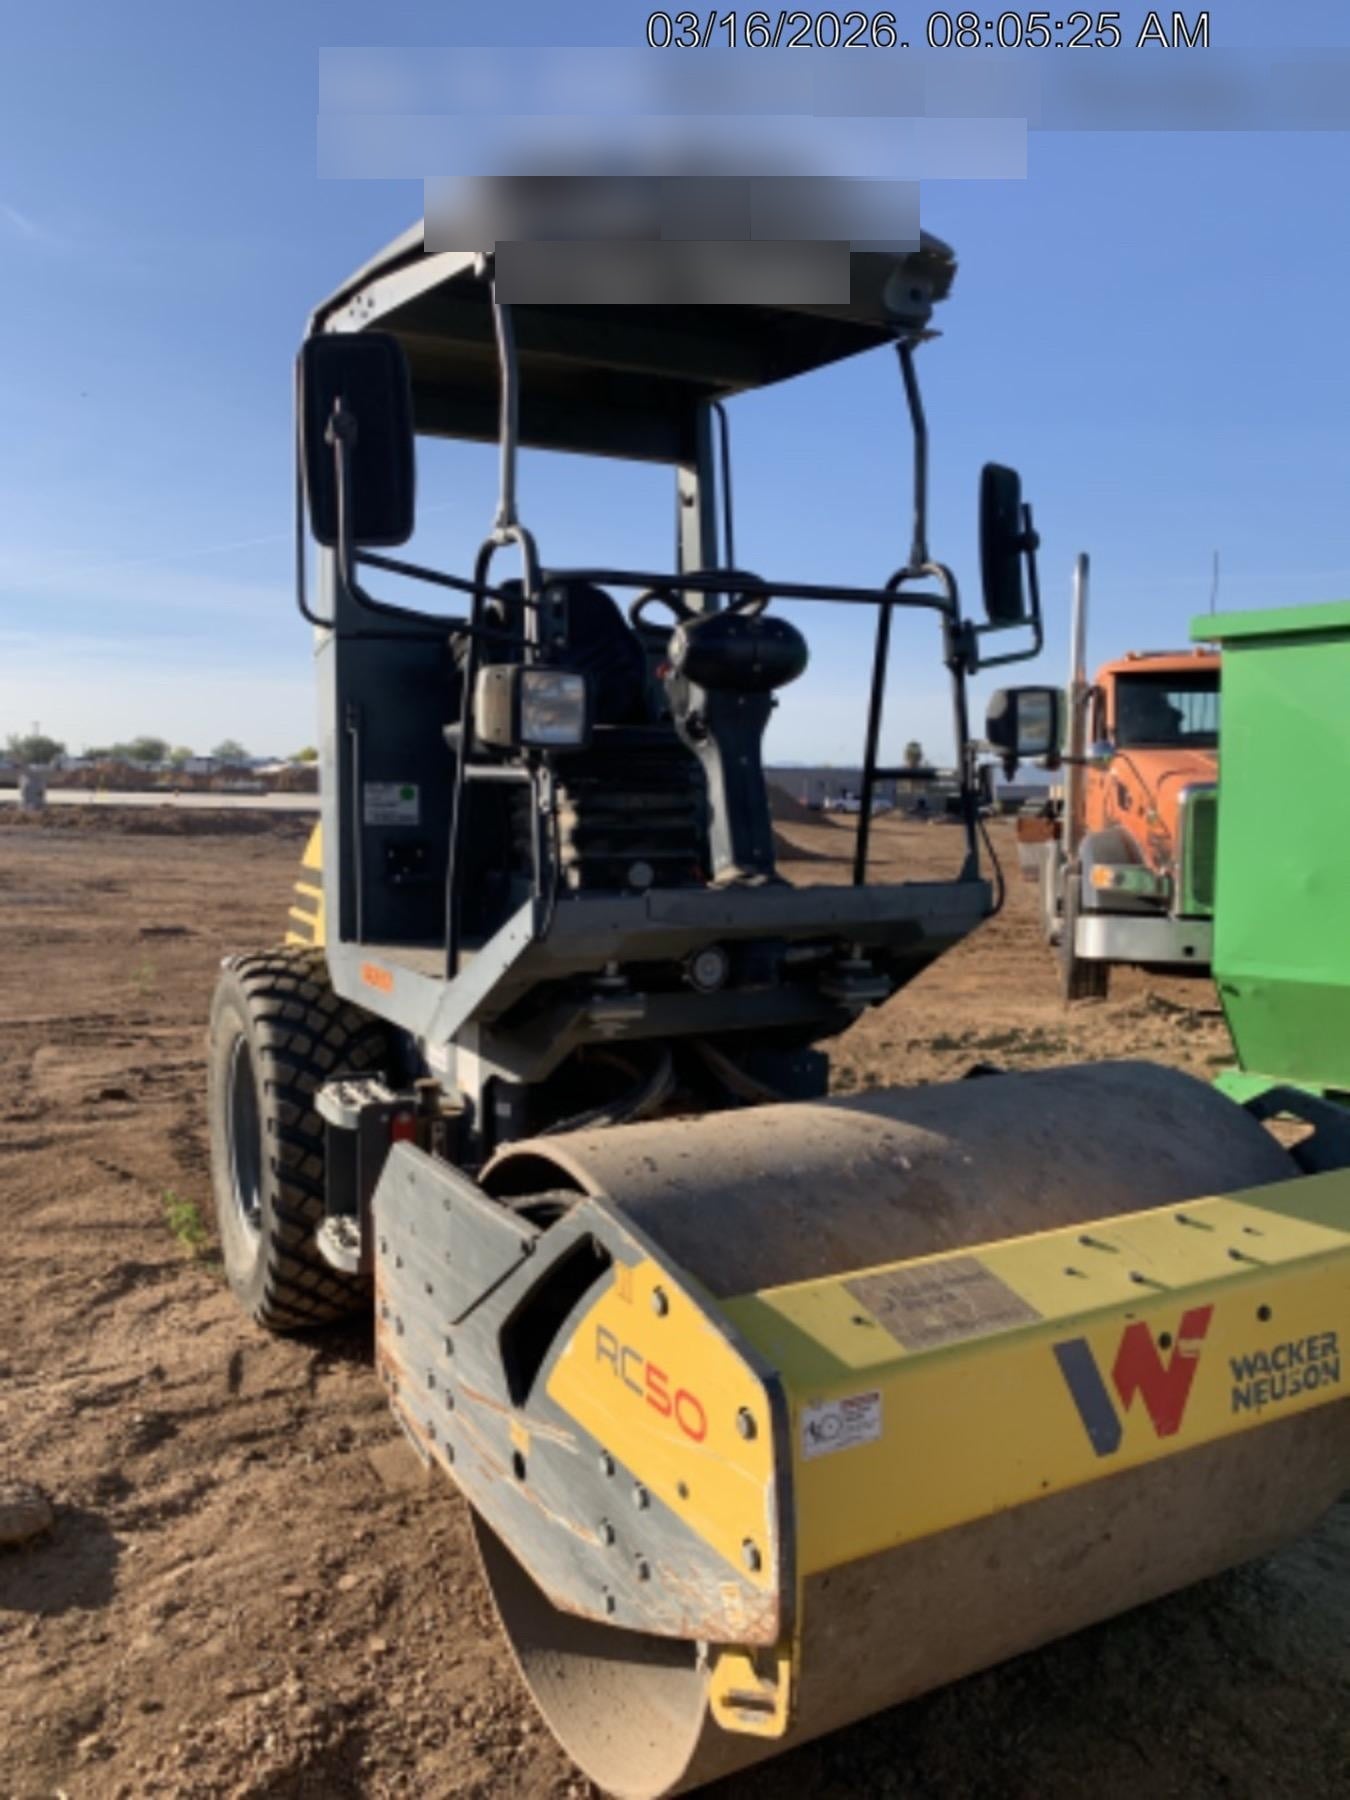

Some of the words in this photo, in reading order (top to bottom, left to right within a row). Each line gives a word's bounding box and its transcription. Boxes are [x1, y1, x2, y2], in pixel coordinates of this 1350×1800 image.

[596, 1323, 708, 1445] RC50
[1229, 1331, 1339, 1382] WACKER
[1231, 1357, 1341, 1414] NEUSON
